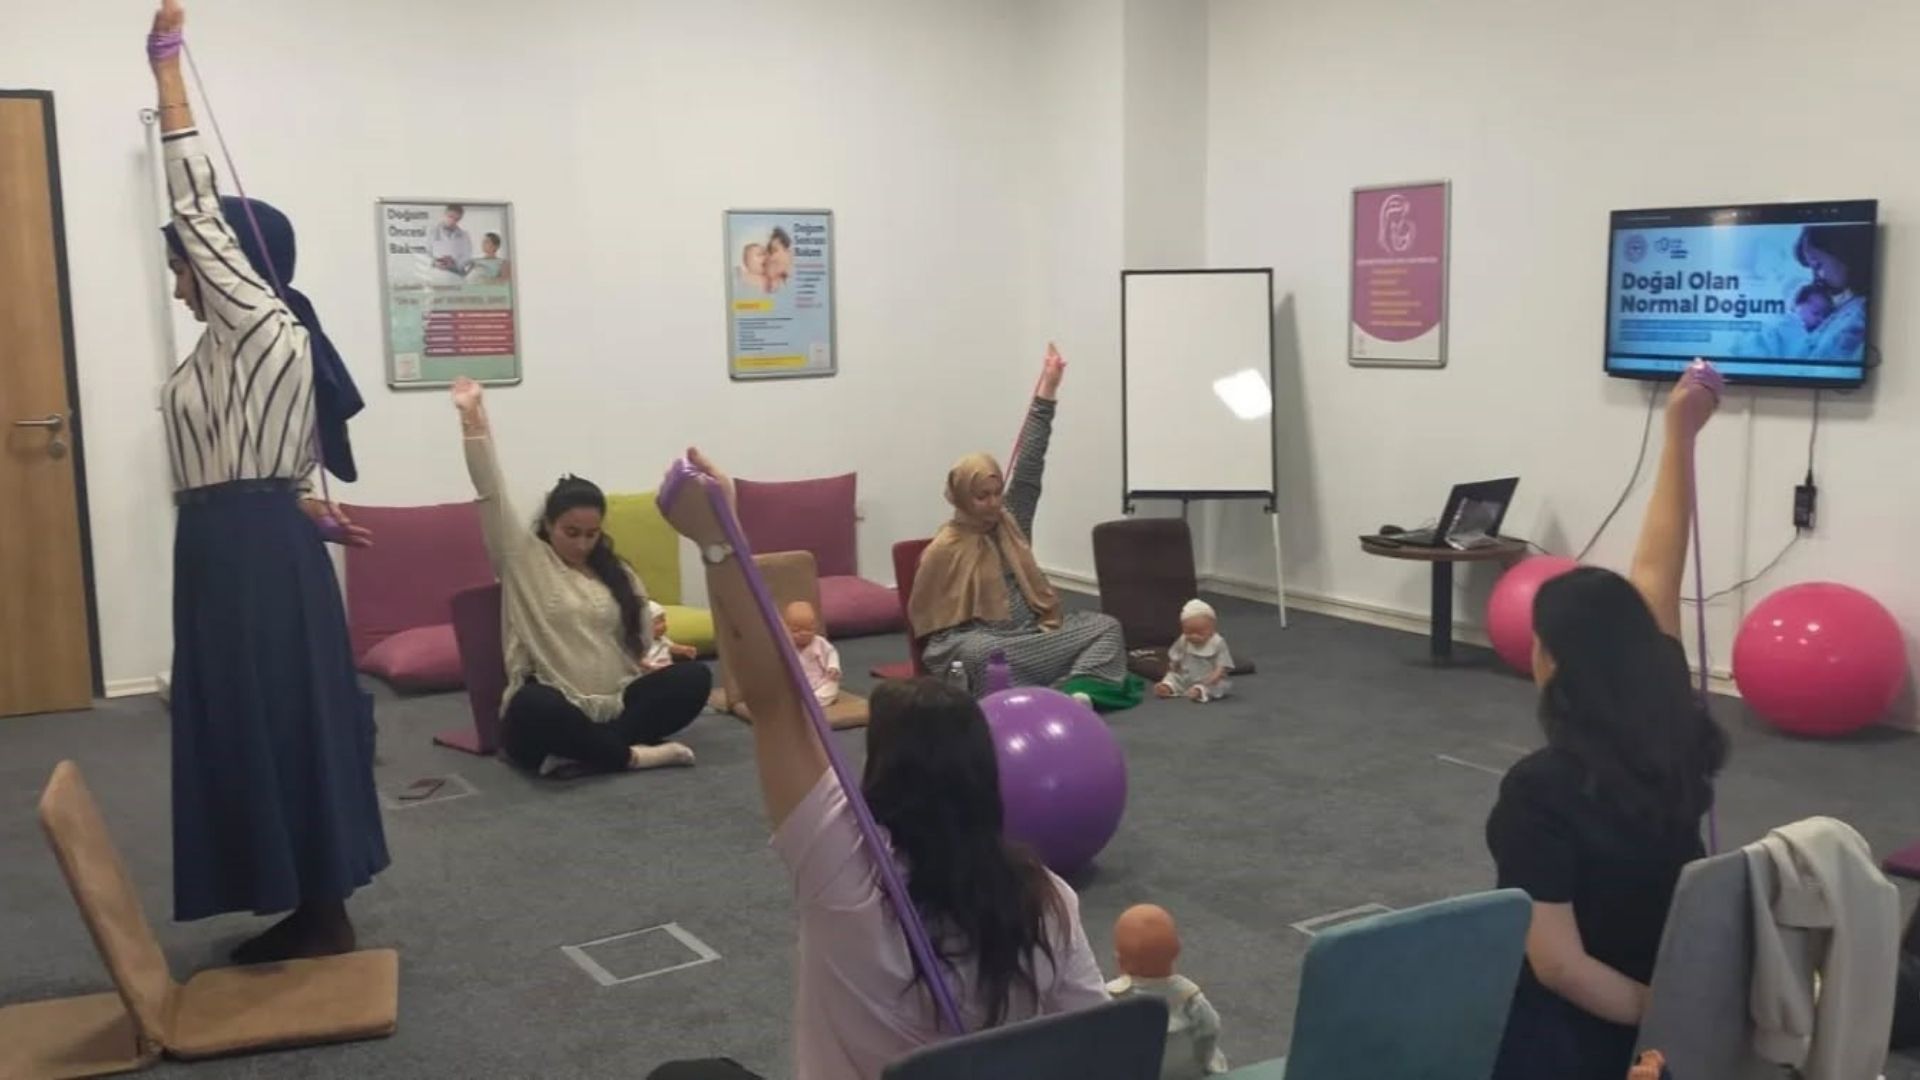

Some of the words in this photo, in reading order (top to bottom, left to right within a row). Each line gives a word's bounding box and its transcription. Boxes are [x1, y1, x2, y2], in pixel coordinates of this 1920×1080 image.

[1621, 271, 1682, 293] Doğal
[1688, 270, 1739, 290] Olan
[1620, 295, 1698, 313] Normal
[1704, 294, 1786, 318] Doğum
